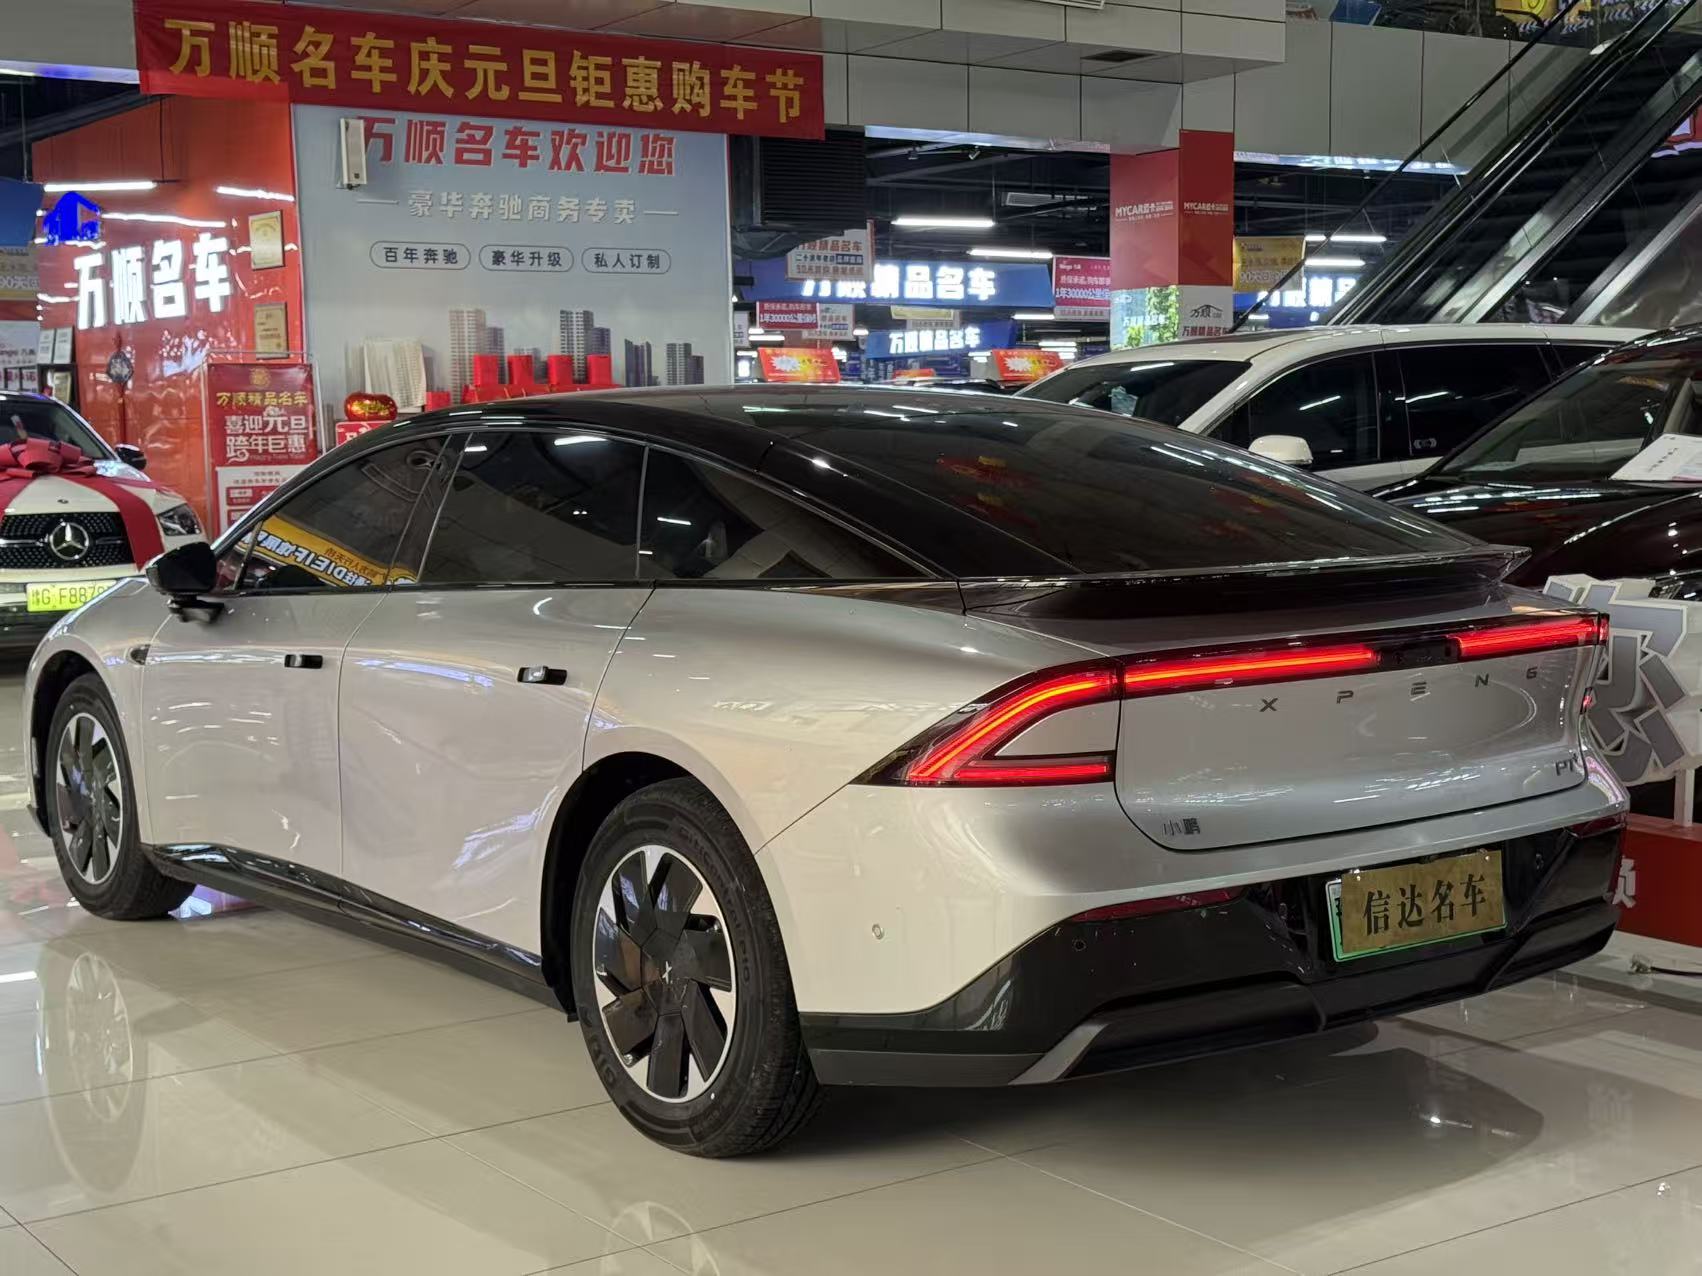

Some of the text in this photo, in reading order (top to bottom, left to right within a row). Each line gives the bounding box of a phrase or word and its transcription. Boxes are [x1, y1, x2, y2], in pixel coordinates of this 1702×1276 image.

[163, 18, 804, 123] 万顺名车庆元旦钜惠购车节
[356, 115, 676, 177] 万顺名车欢迎您
[408, 190, 638, 225] 豪华奔驰商务专卖
[383, 246, 458, 265] 百年奔驰
[491, 250, 563, 268] 豪华升级
[594, 252, 662, 271] 私人订制
[74, 233, 230, 329] 万顺名车
[225, 412, 308, 434] 喜迎元旦
[226, 435, 306, 464] 跨年巨惠
[1163, 818, 1201, 836] 小鹏
[1363, 874, 1487, 936] 信达名车
